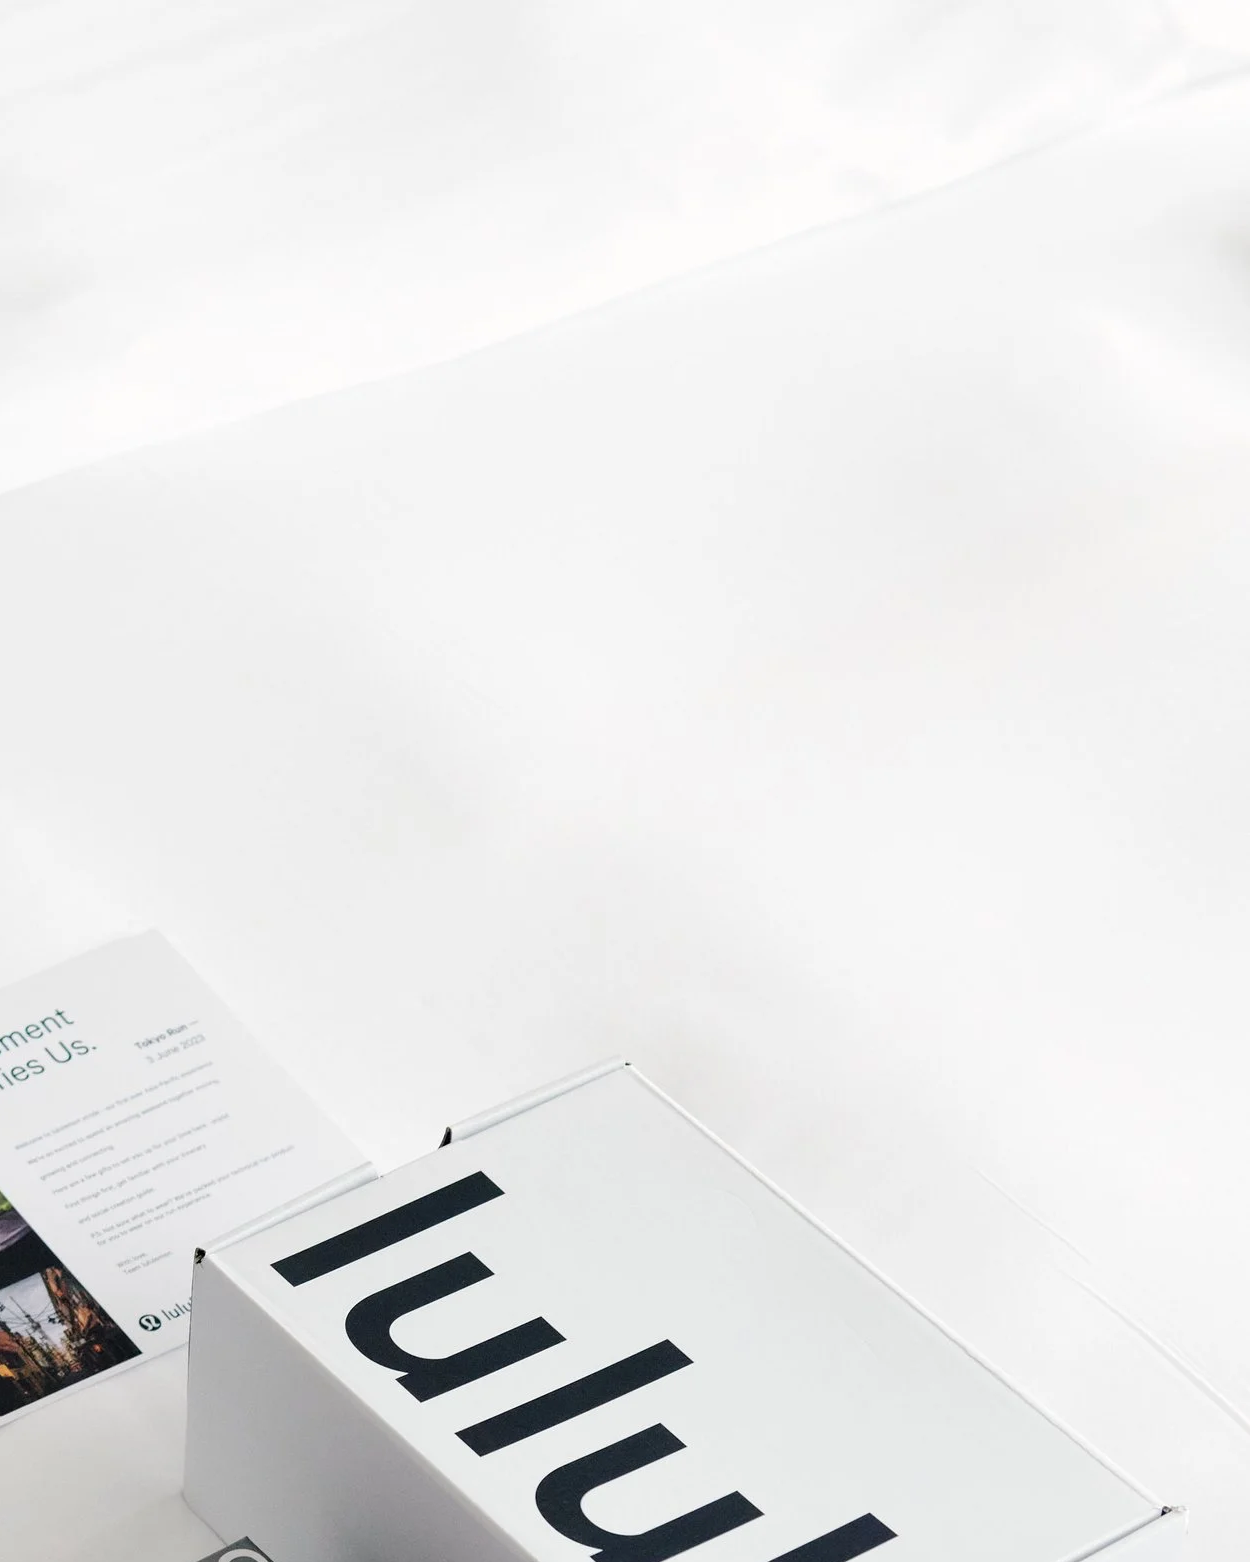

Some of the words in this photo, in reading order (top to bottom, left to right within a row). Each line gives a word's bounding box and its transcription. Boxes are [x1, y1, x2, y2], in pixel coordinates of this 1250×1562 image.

[45, 1037, 97, 1064] Us.
[134, 1030, 166, 1053] Tokyo
[166, 1024, 188, 1042] Run
[157, 1043, 180, 1062] June
[161, 1297, 192, 1321] lulu
